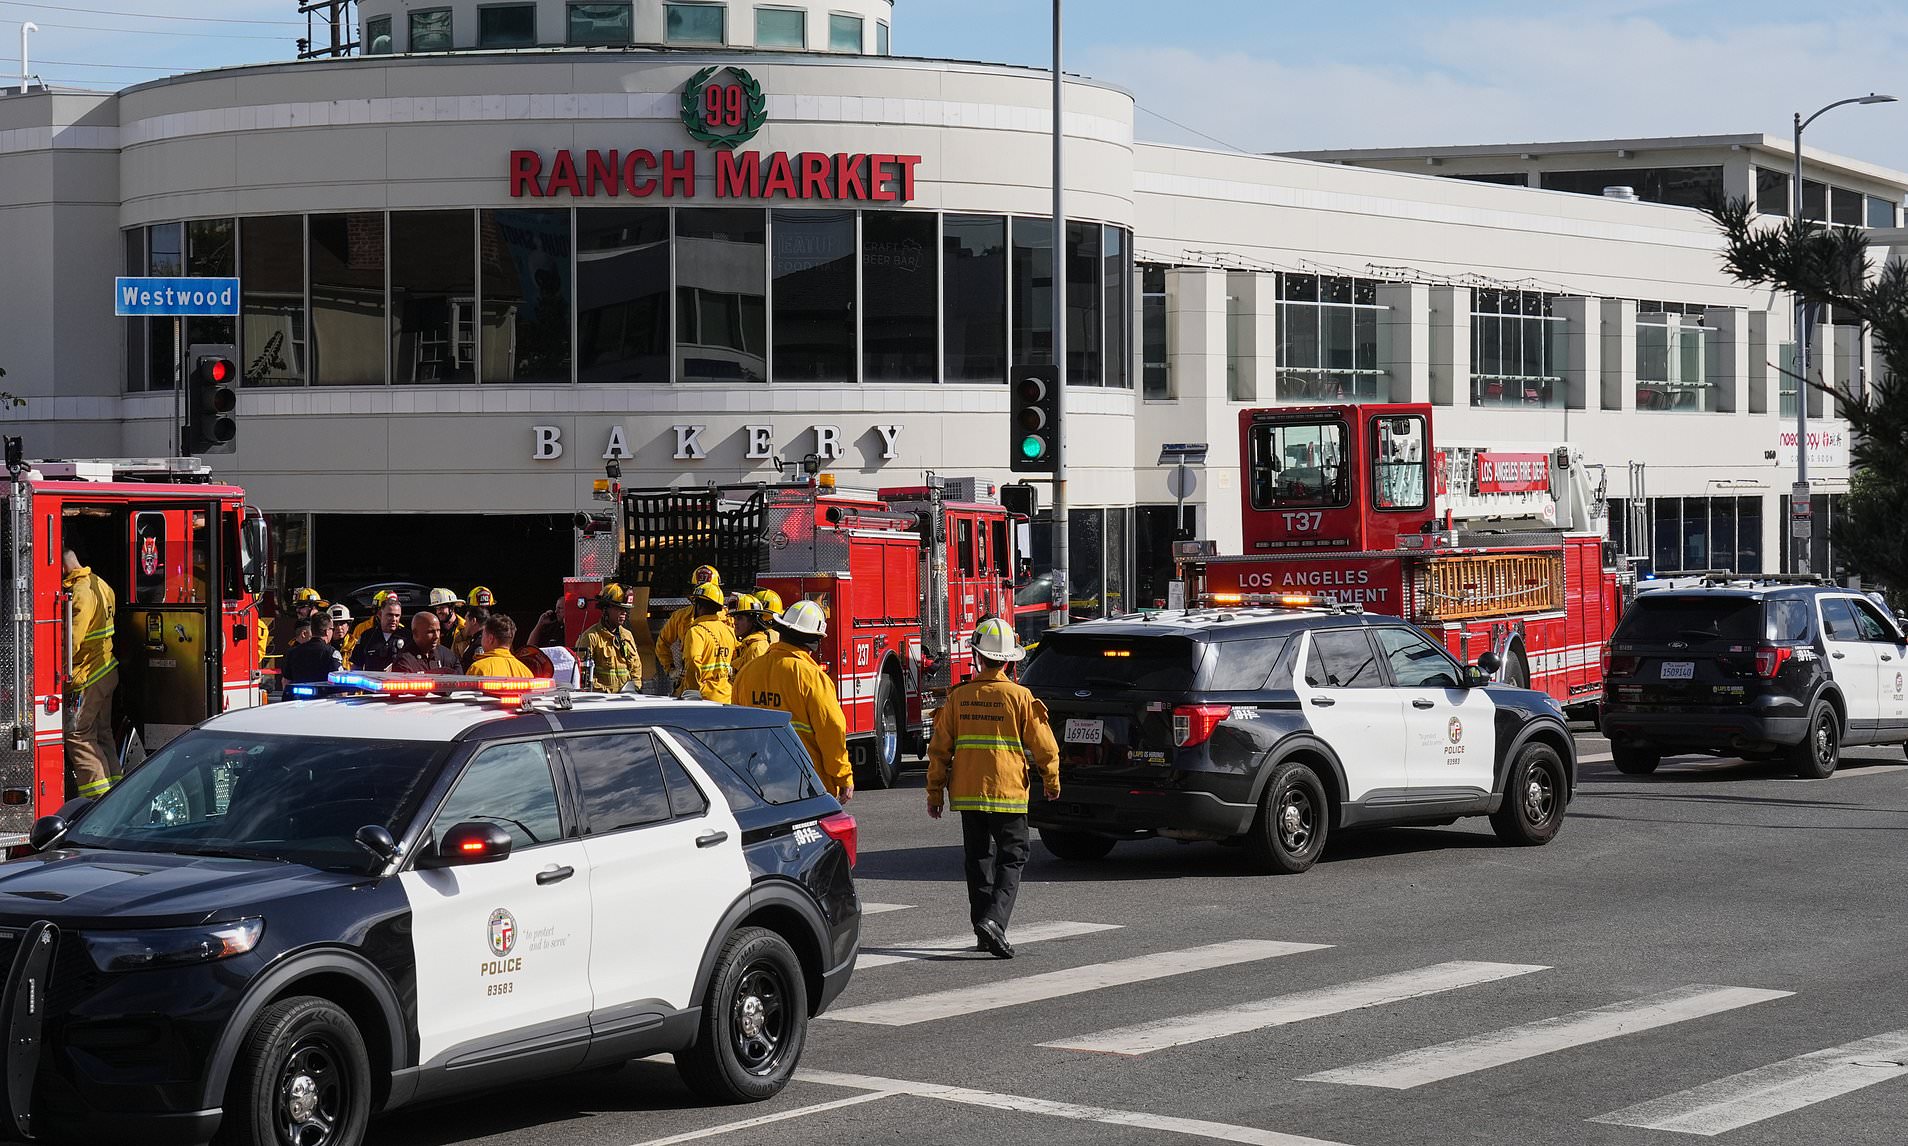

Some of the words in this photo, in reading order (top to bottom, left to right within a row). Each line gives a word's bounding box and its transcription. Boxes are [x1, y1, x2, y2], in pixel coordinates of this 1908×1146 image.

[704, 84, 741, 127] 99
[510, 149, 695, 198] RANCH
[715, 150, 922, 202] MARKET
[864, 242, 898, 252] CRAFT
[864, 255, 890, 265] BEER
[122, 286, 232, 306] Westwood
[532, 425, 904, 460] BAKERY
[1480, 461, 1493, 482] LOS
[1494, 461, 1518, 481] ANGELES
[1520, 461, 1531, 480] FIRE
[1282, 511, 1322, 531] T37
[1239, 573, 1273, 587] LOS
[1282, 570, 1369, 586] ANGELES
[857, 643, 870, 666] 237
[751, 690, 782, 707] LAFD
[971, 714, 1005, 722] DEPARTMENT
[1067, 727, 1100, 740] 1697665
[1444, 745, 1465, 755] POLICE
[481, 957, 522, 976] POLICE
[487, 982, 513, 996] 83583
